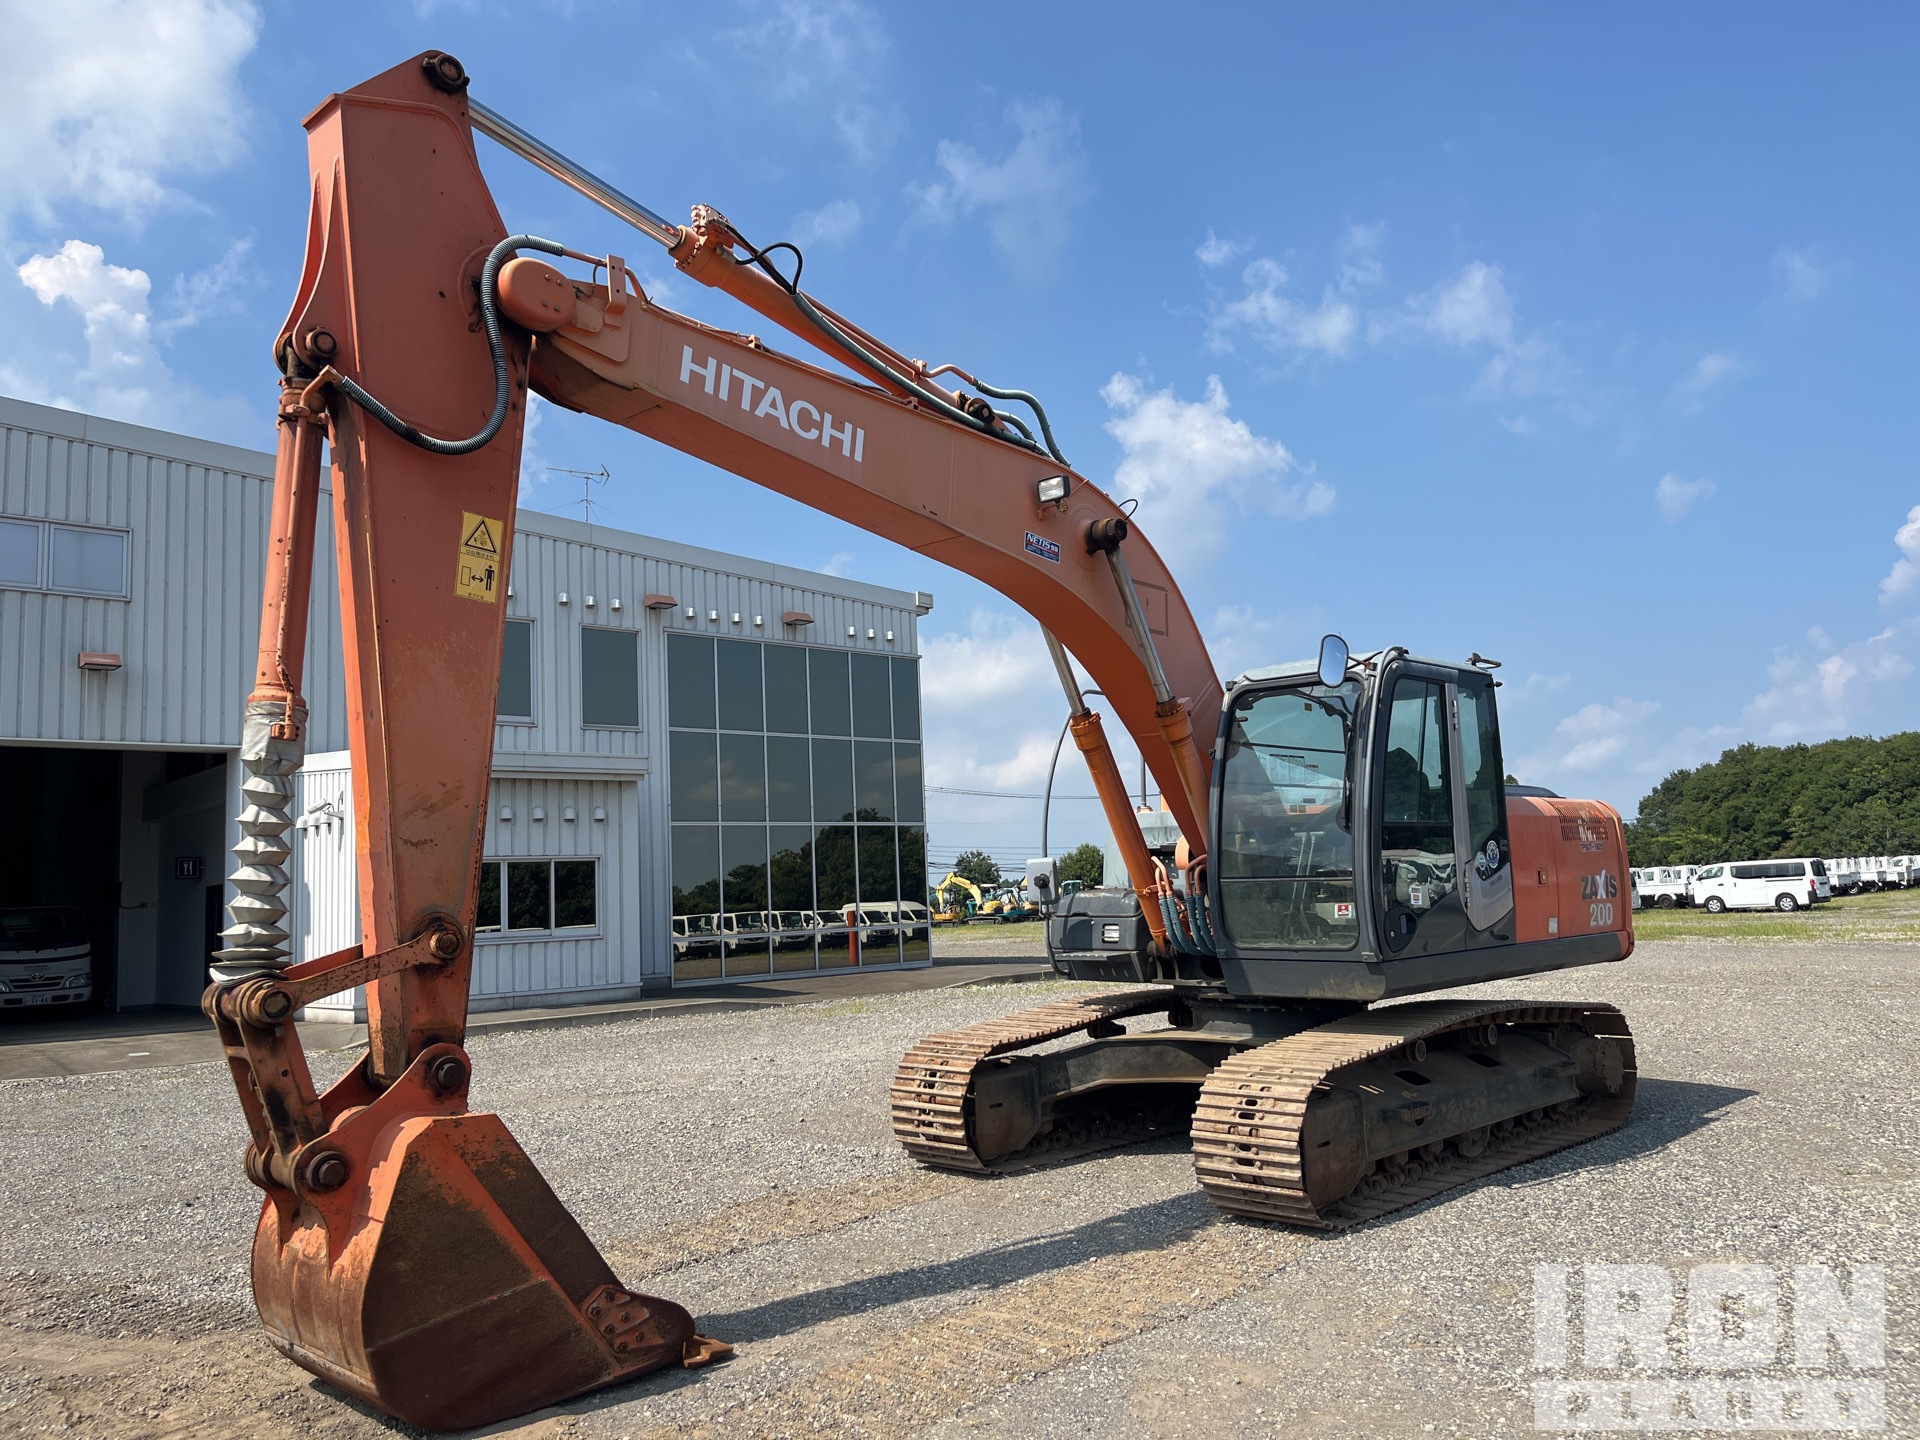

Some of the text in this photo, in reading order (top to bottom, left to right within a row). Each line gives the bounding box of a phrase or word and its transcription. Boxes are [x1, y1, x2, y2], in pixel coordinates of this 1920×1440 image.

[679, 345, 865, 463] HITACHI
[1026, 533, 1051, 549] NETIS
[1581, 869, 1617, 900] ZAXIS
[1589, 902, 1613, 927] 200
